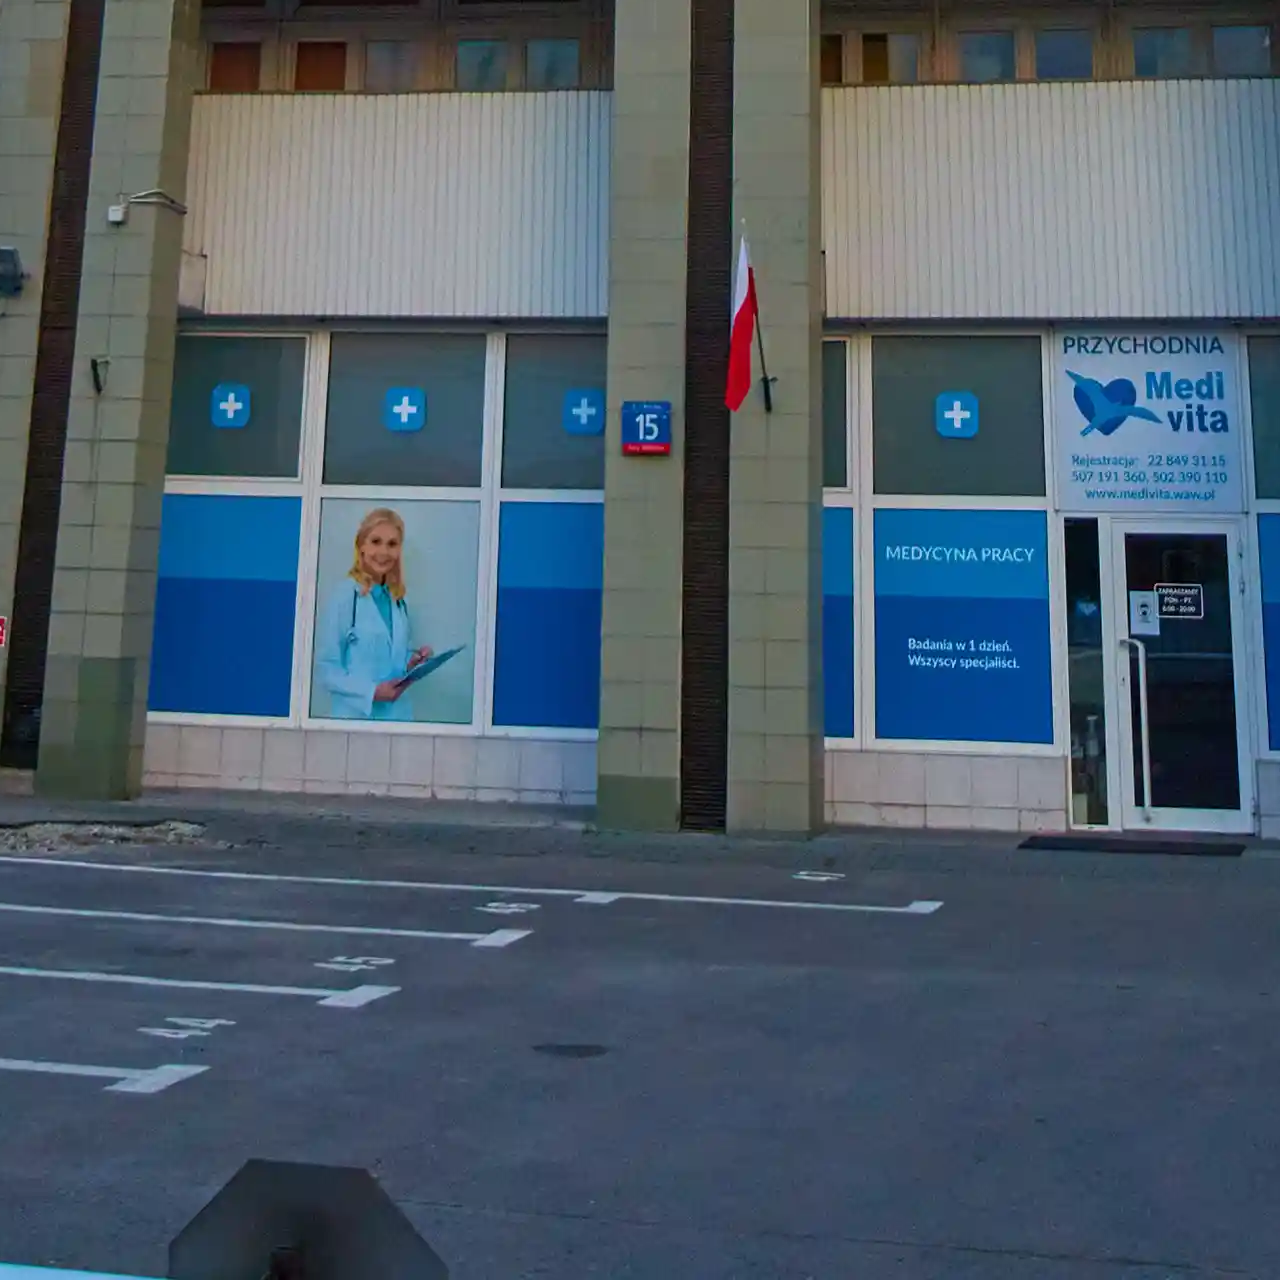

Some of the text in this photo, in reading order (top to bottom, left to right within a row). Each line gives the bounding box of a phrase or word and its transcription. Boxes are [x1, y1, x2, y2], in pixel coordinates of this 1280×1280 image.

[1063, 335, 1225, 355] PRZYCHODNIA
[1145, 371, 1225, 400] Medi
[635, 413, 659, 441] 15
[1167, 403, 1229, 433] vita
[1147, 454, 1163, 467] 22
[886, 545, 1035, 562] MEDYCYNA PRACY
[908, 637, 1013, 652] Badania w 1 dzień.
[908, 654, 1020, 671] Wszyscy specjaliści.
[136, 1017, 238, 1039] 44
